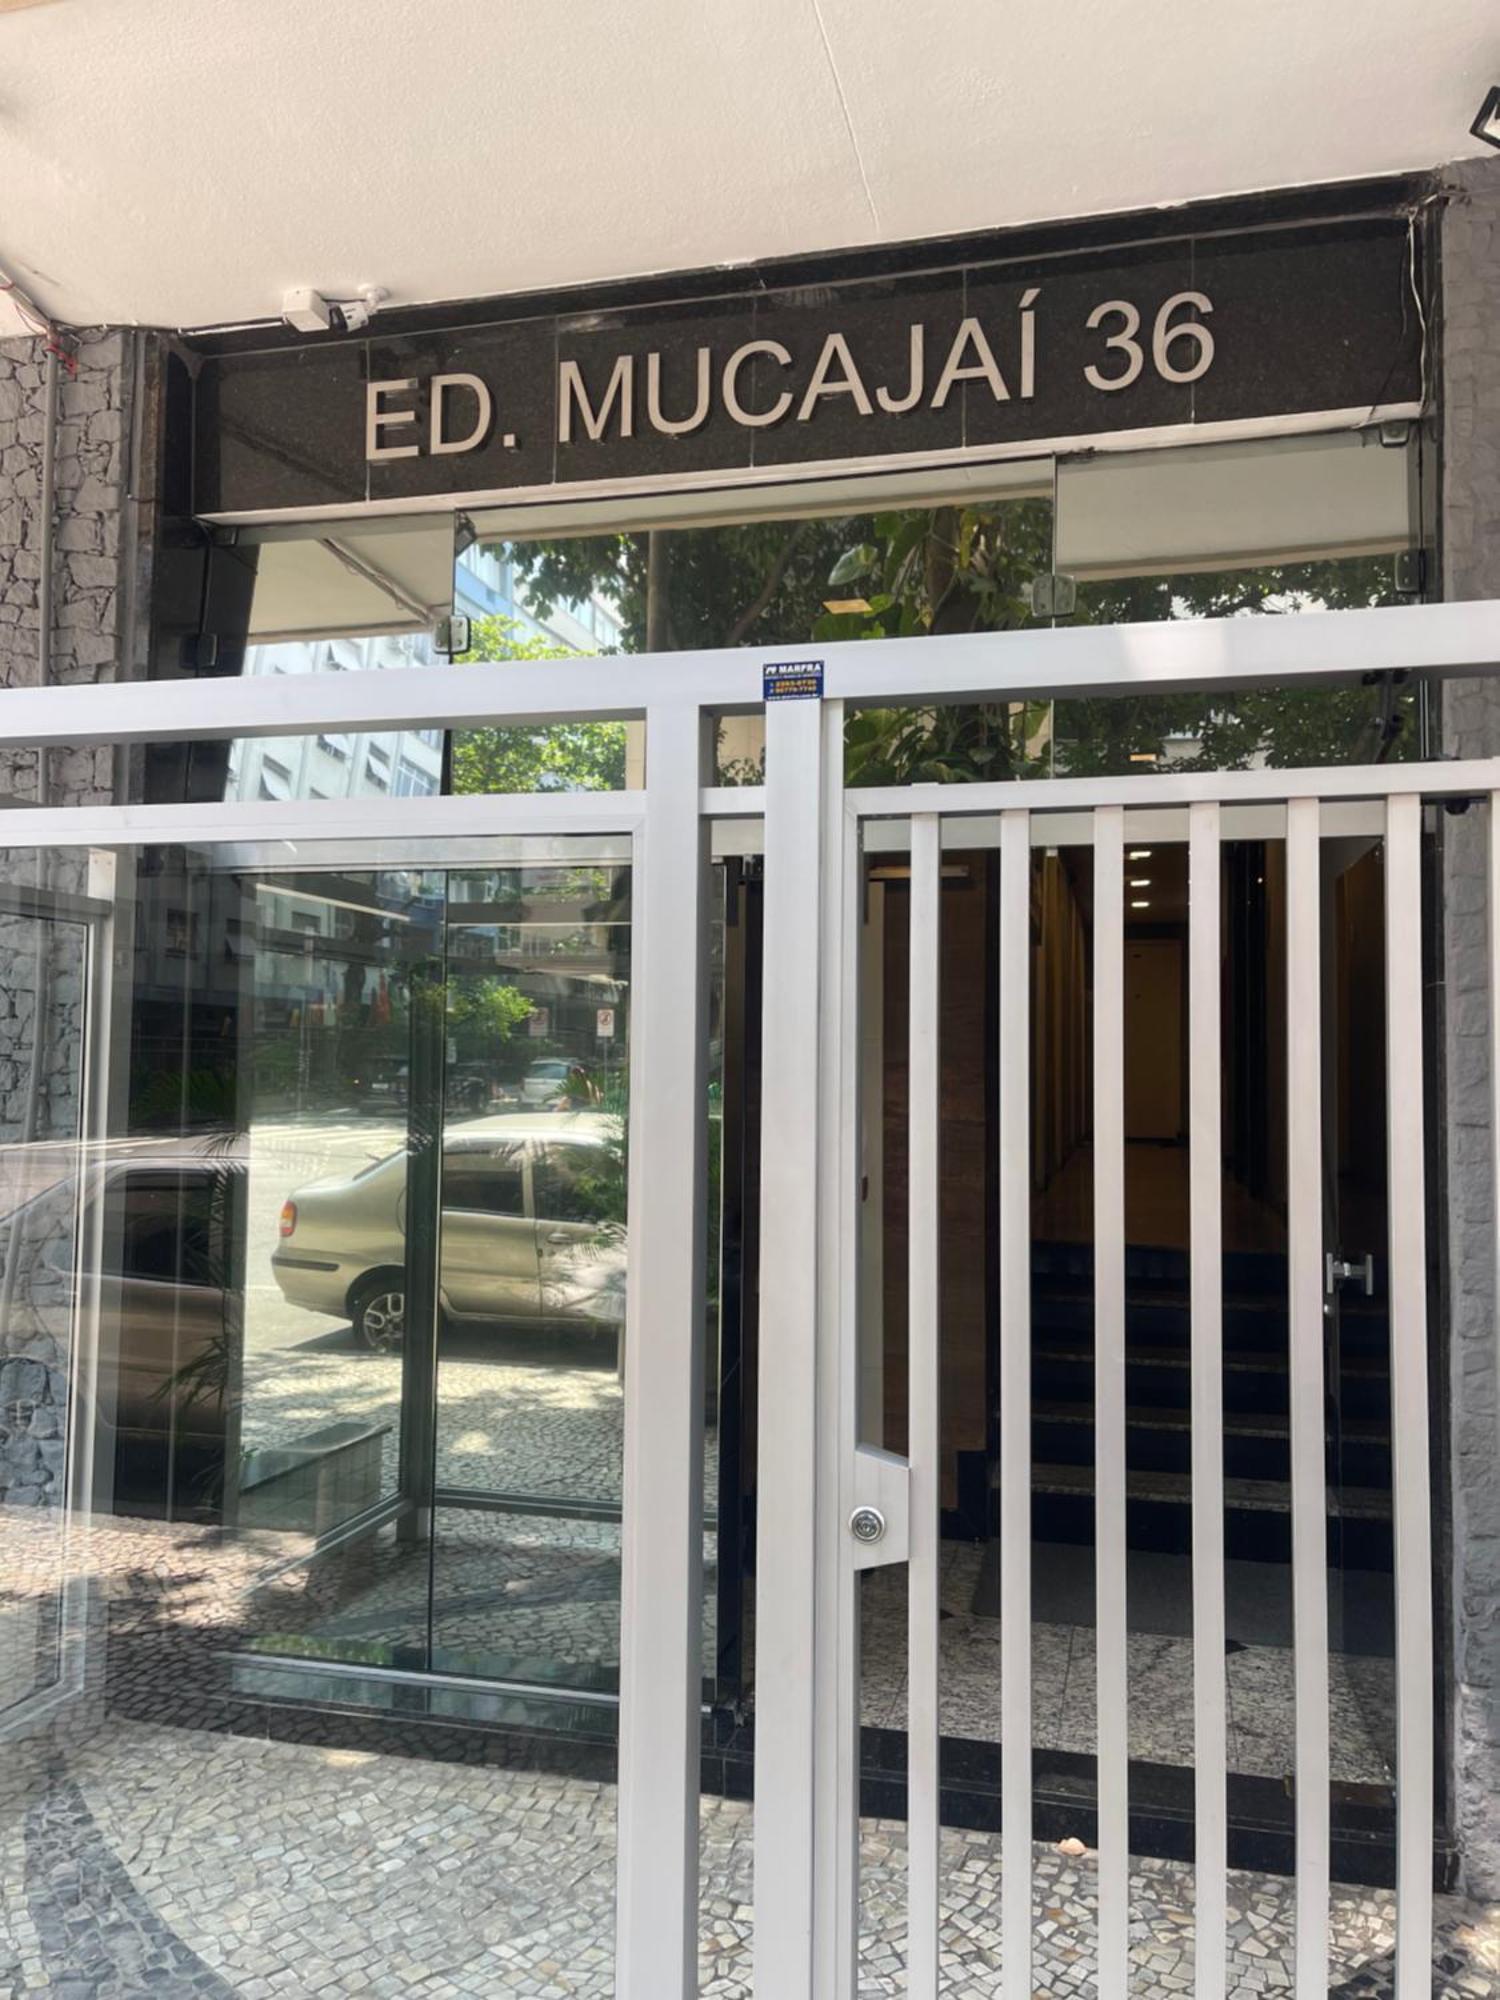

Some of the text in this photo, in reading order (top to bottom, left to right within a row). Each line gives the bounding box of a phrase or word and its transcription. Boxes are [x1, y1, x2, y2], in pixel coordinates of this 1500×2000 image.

[365, 288, 1215, 461] ED. MUCAJAÍ 36
